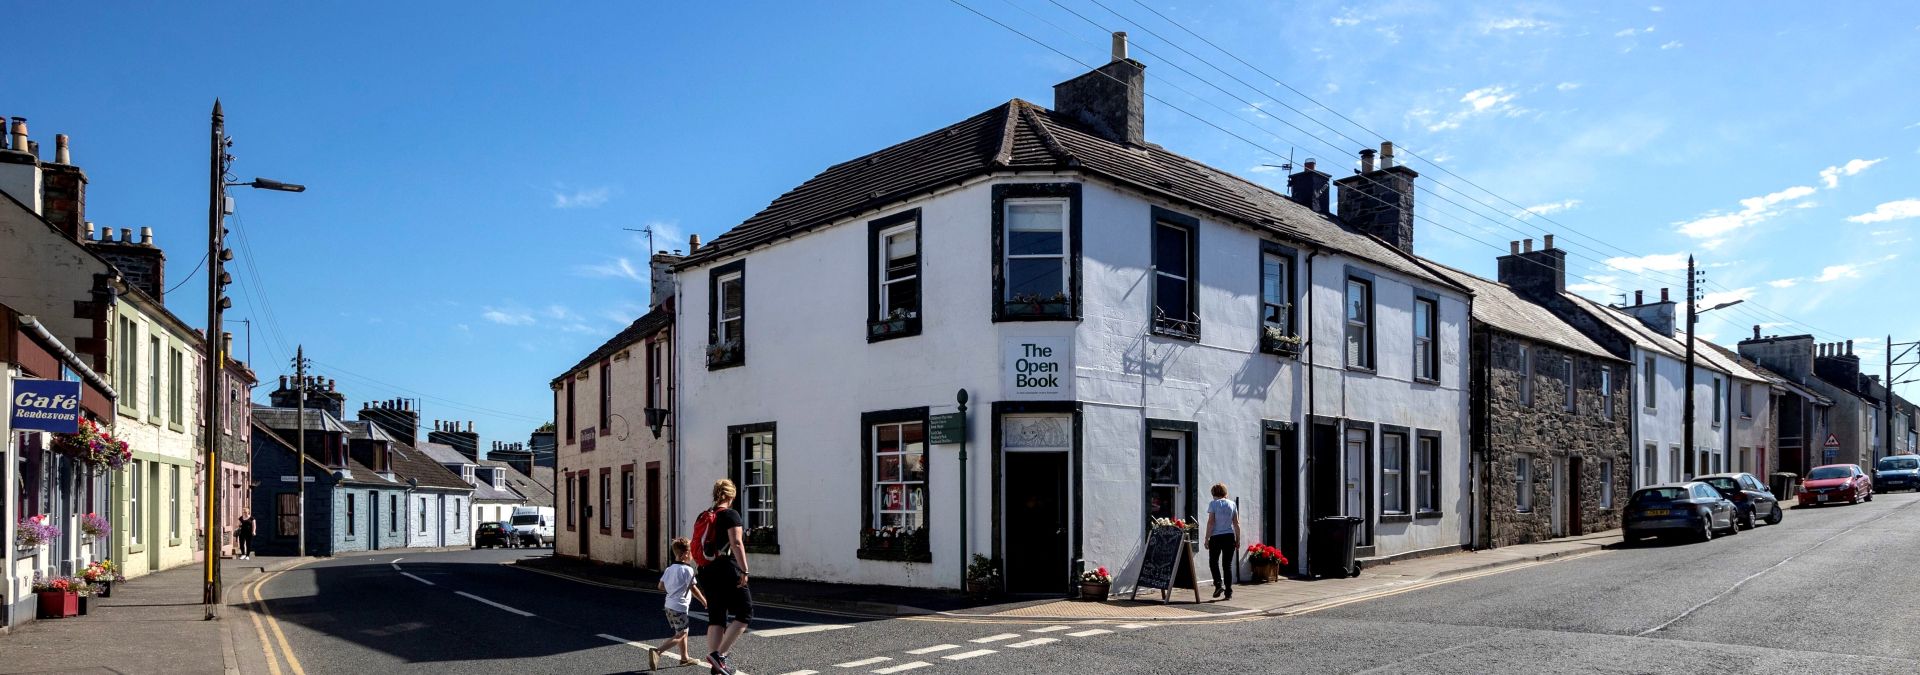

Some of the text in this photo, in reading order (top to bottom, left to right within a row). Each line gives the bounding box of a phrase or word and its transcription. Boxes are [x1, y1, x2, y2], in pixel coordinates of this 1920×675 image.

[1021, 344, 1052, 357] The
[1016, 358, 1058, 375] Open
[1016, 374, 1059, 387] Book
[15, 392, 77, 410] Café
[16, 409, 75, 420] Rendezvous
